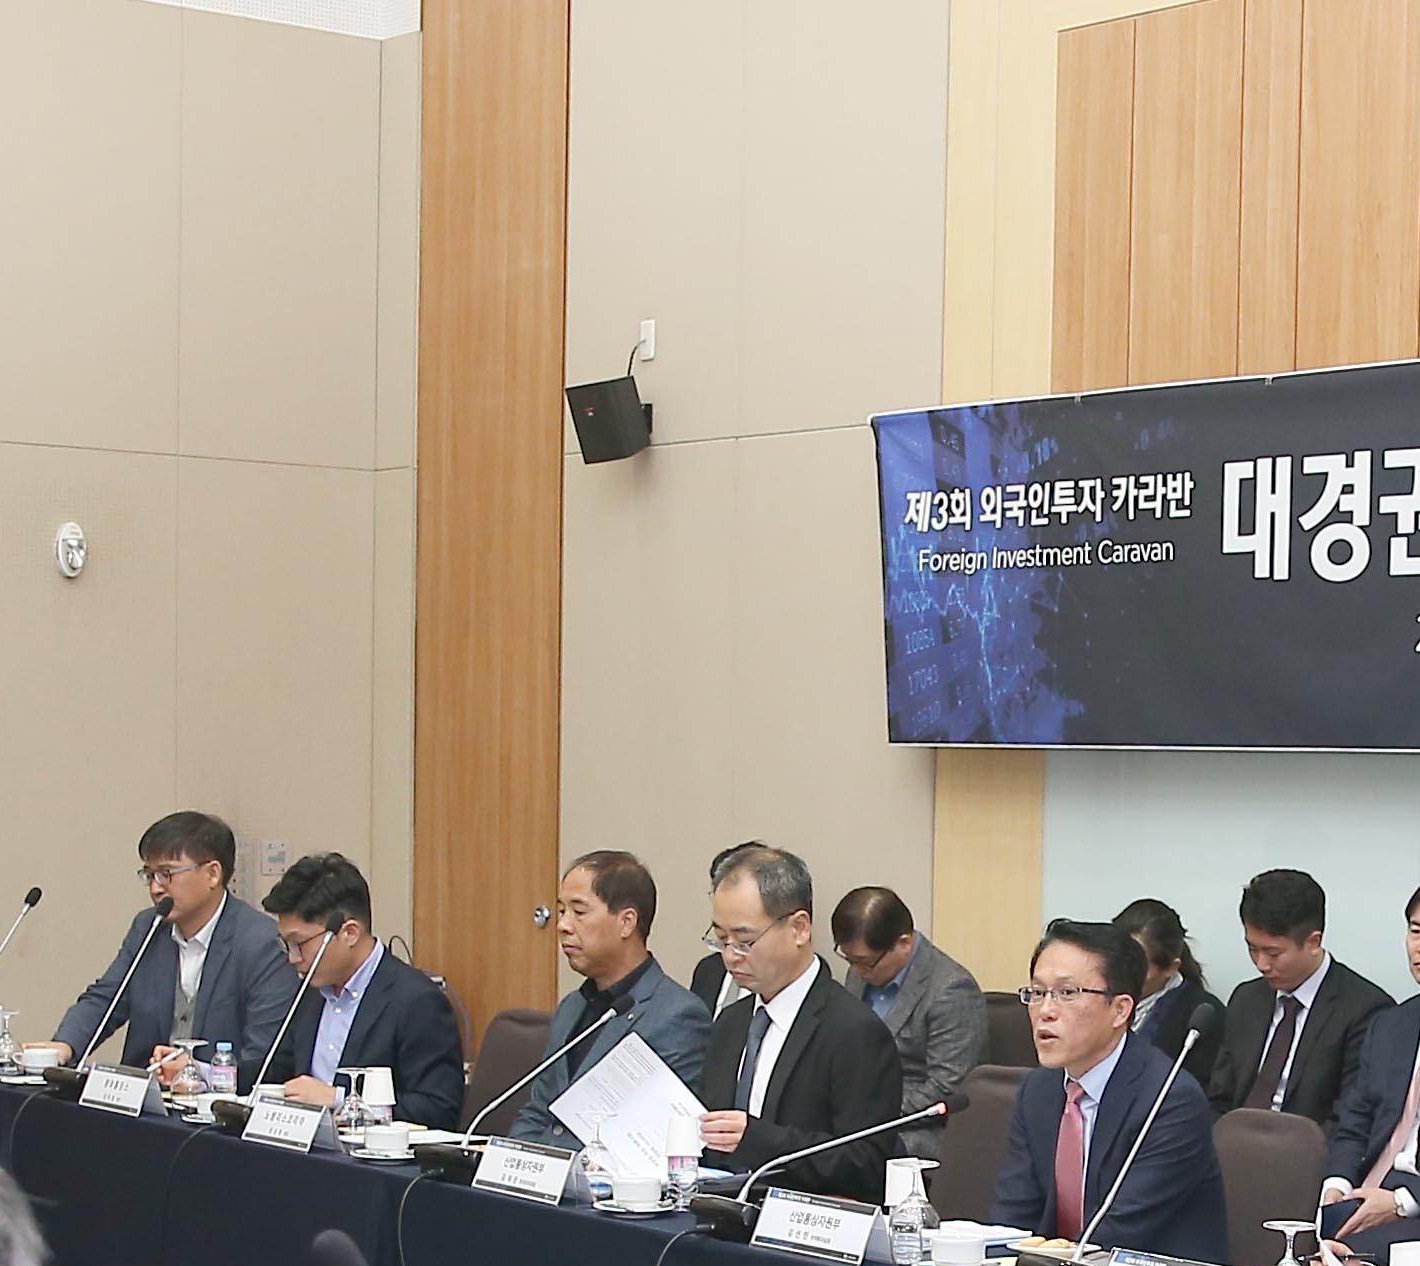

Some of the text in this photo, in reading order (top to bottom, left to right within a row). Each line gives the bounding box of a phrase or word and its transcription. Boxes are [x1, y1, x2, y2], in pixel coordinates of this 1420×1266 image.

[903, 471, 1195, 534] 제3회 외국인투자 카라반
[917, 539, 1175, 575] Foreign Investment Caravan
